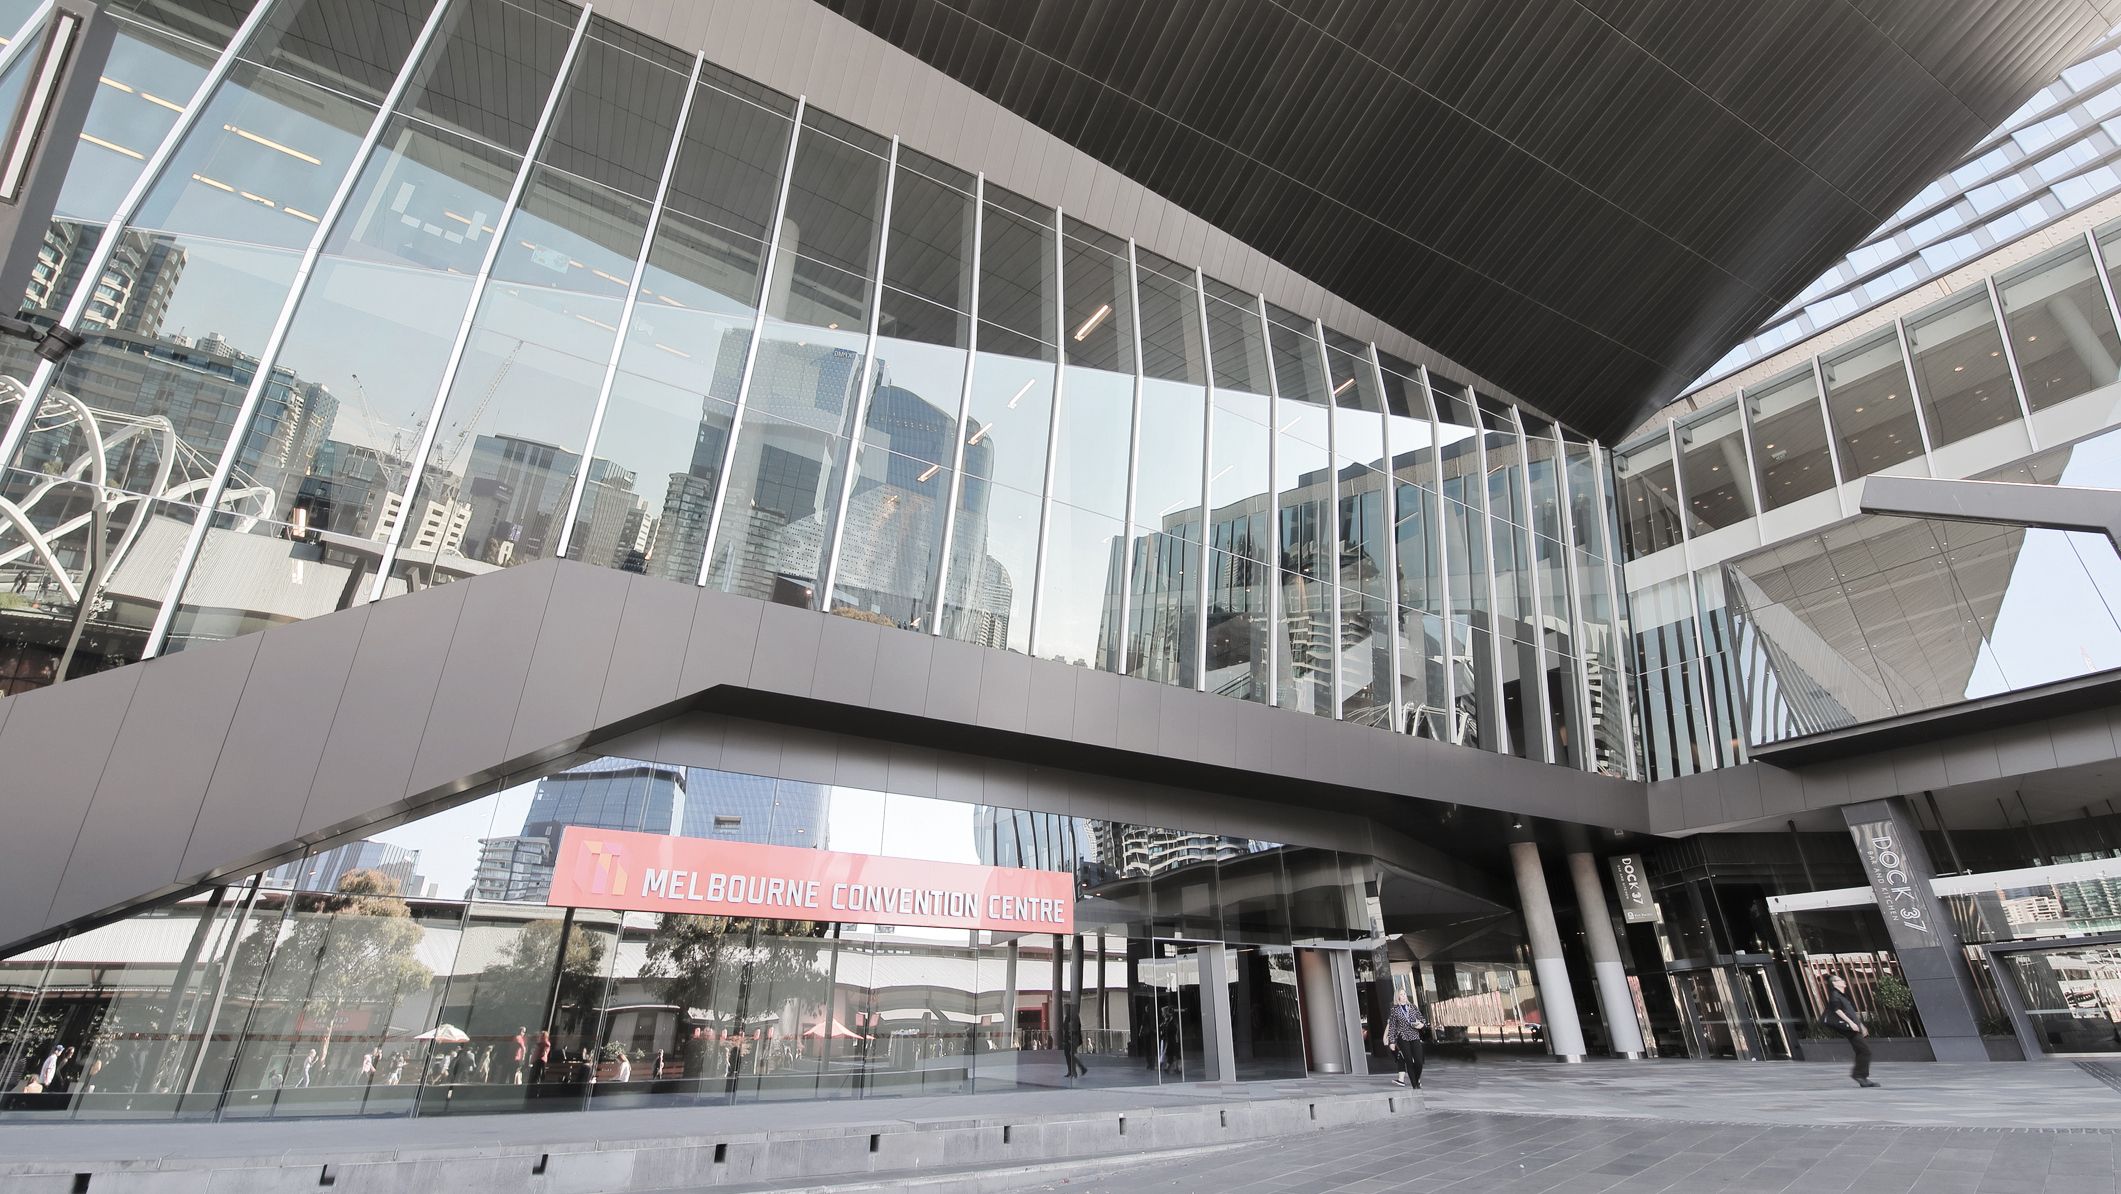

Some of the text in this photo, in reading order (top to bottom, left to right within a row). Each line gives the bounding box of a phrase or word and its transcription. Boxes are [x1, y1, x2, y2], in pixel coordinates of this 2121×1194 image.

[641, 868, 1065, 923] MELBOURNE CONVENTION CENTRE
[1621, 857, 1639, 890] DOCK
[1631, 891, 1644, 905] 37
[1867, 851, 1899, 921] BAR AND KITCHEN
[1872, 836, 1928, 933] DOCK 37
